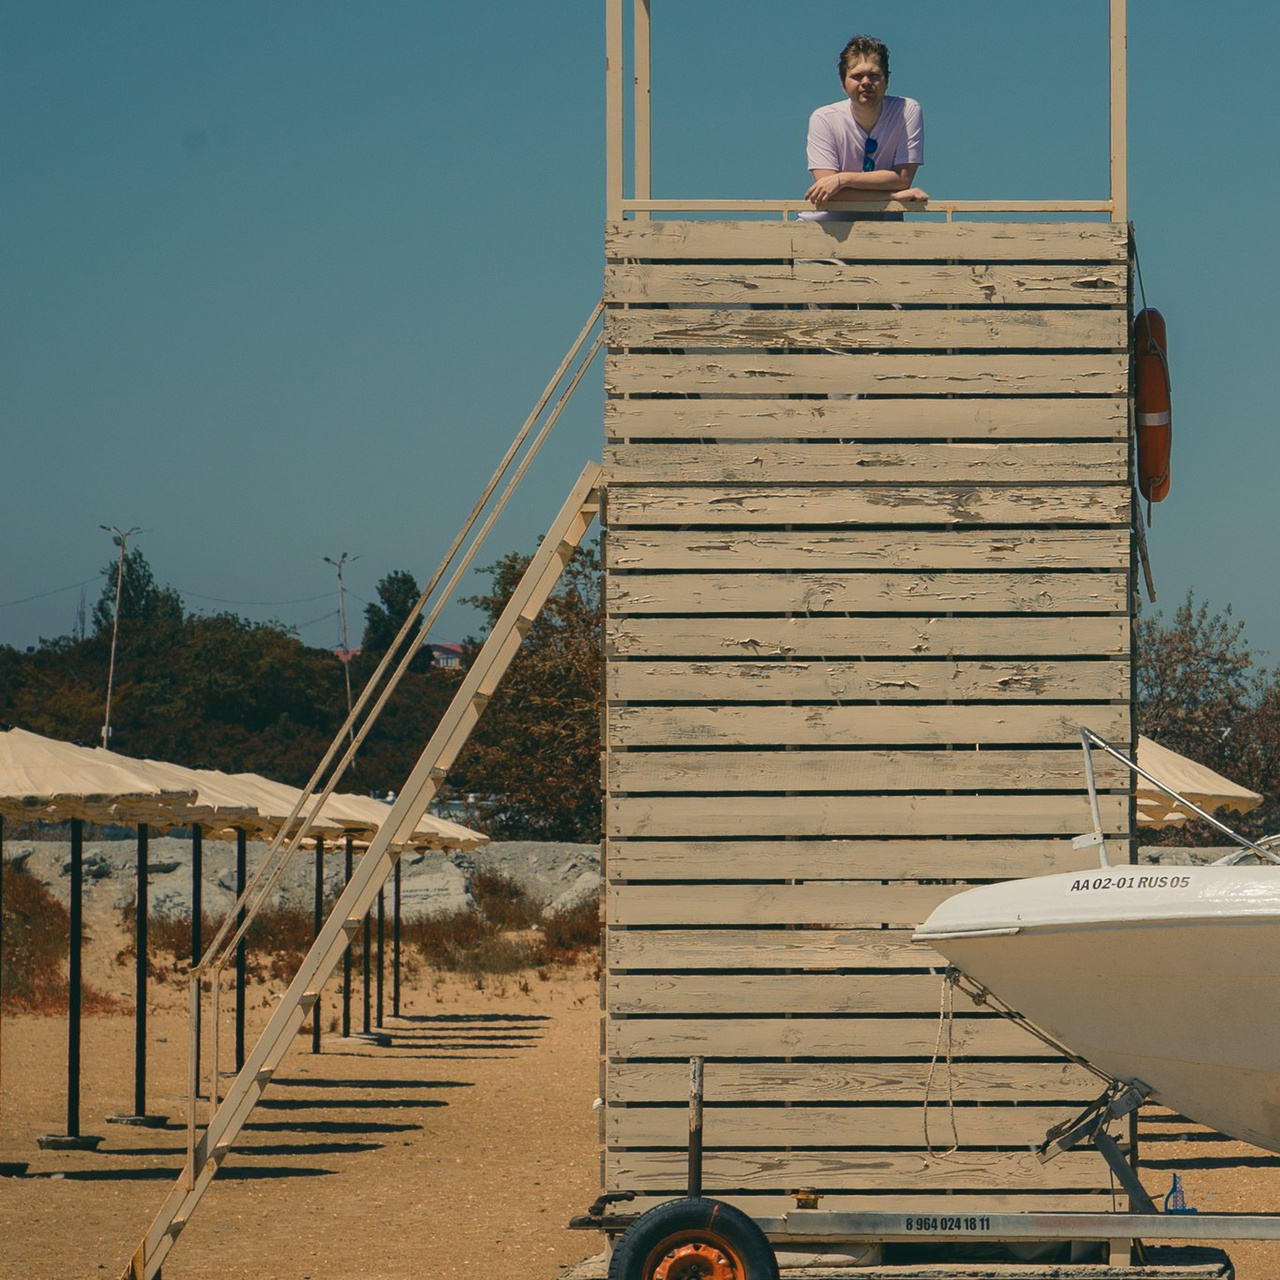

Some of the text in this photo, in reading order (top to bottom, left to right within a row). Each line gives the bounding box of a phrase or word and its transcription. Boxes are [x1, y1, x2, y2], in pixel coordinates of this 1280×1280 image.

[1092, 877, 1135, 890] 02-01
[1137, 876, 1169, 888] RUS
[1170, 876, 1190, 888] 05
[906, 1218, 990, 1231] 8 964 024 18 11
